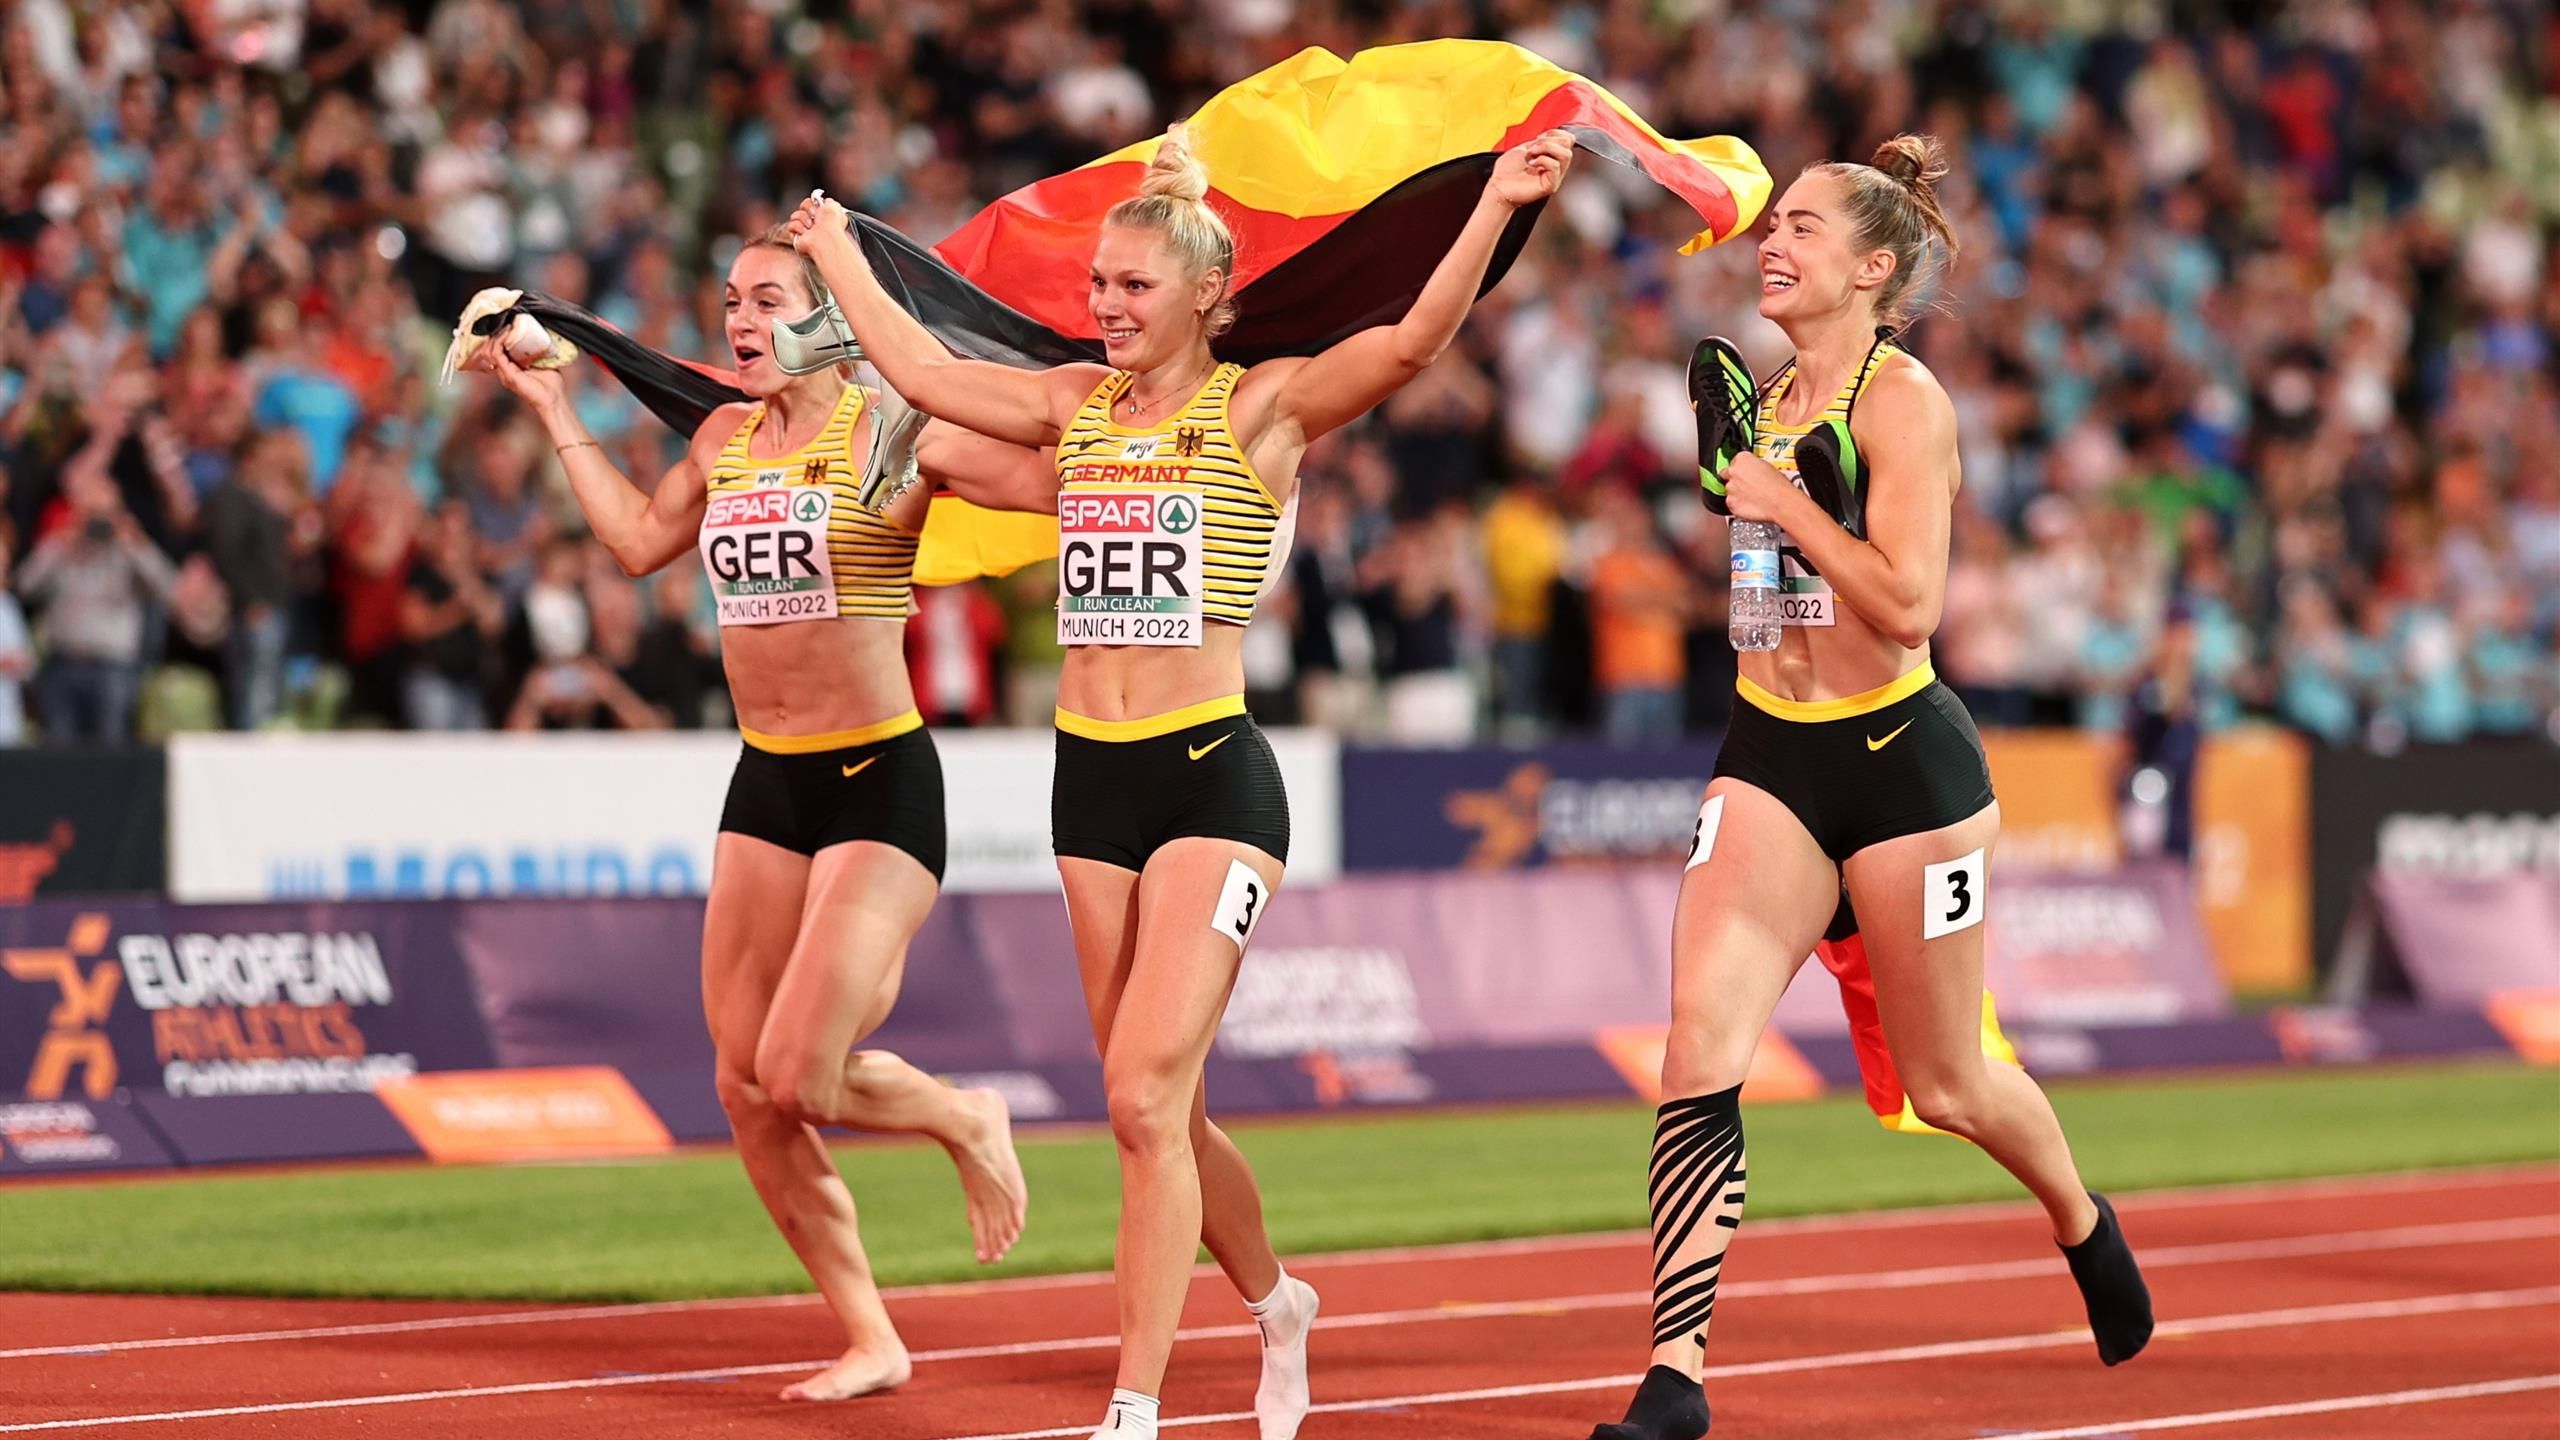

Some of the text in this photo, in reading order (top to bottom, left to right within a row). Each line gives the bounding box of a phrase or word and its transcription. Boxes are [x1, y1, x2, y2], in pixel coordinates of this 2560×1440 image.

[1071, 463, 1193, 483] GERMANY
[709, 494, 788, 526] SPAR
[1061, 499, 1151, 528] SPAR
[709, 530, 822, 583] GER
[1064, 541, 1190, 598] GER
[722, 594, 827, 618] MUNICH 2022
[1084, 598, 1107, 611] RUN
[1062, 618, 1190, 639] MUNICH 2022
[1235, 882, 1258, 937] 3
[1945, 869, 1972, 922] 3
[117, 932, 394, 1010] EUROPEAN
